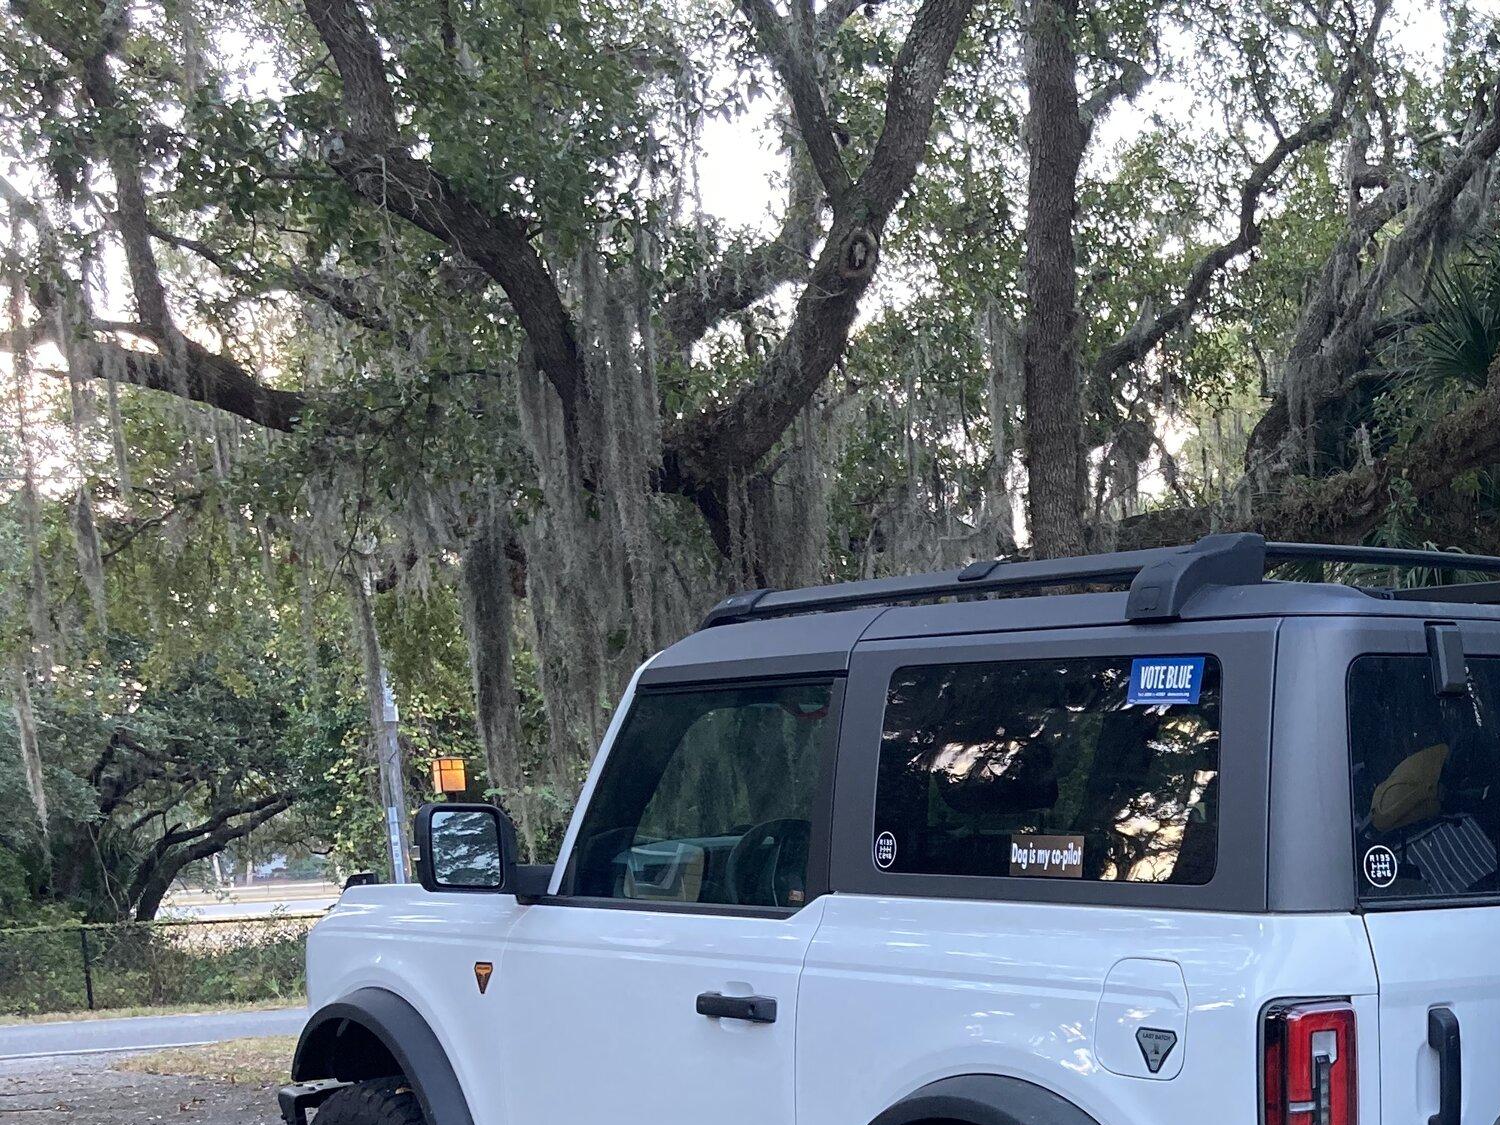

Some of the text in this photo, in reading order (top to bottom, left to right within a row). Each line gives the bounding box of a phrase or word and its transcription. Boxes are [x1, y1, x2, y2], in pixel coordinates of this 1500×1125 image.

[1141, 665, 1194, 689] VOTE BLUE
[1011, 842, 1081, 871] Dog is my co-pilot
